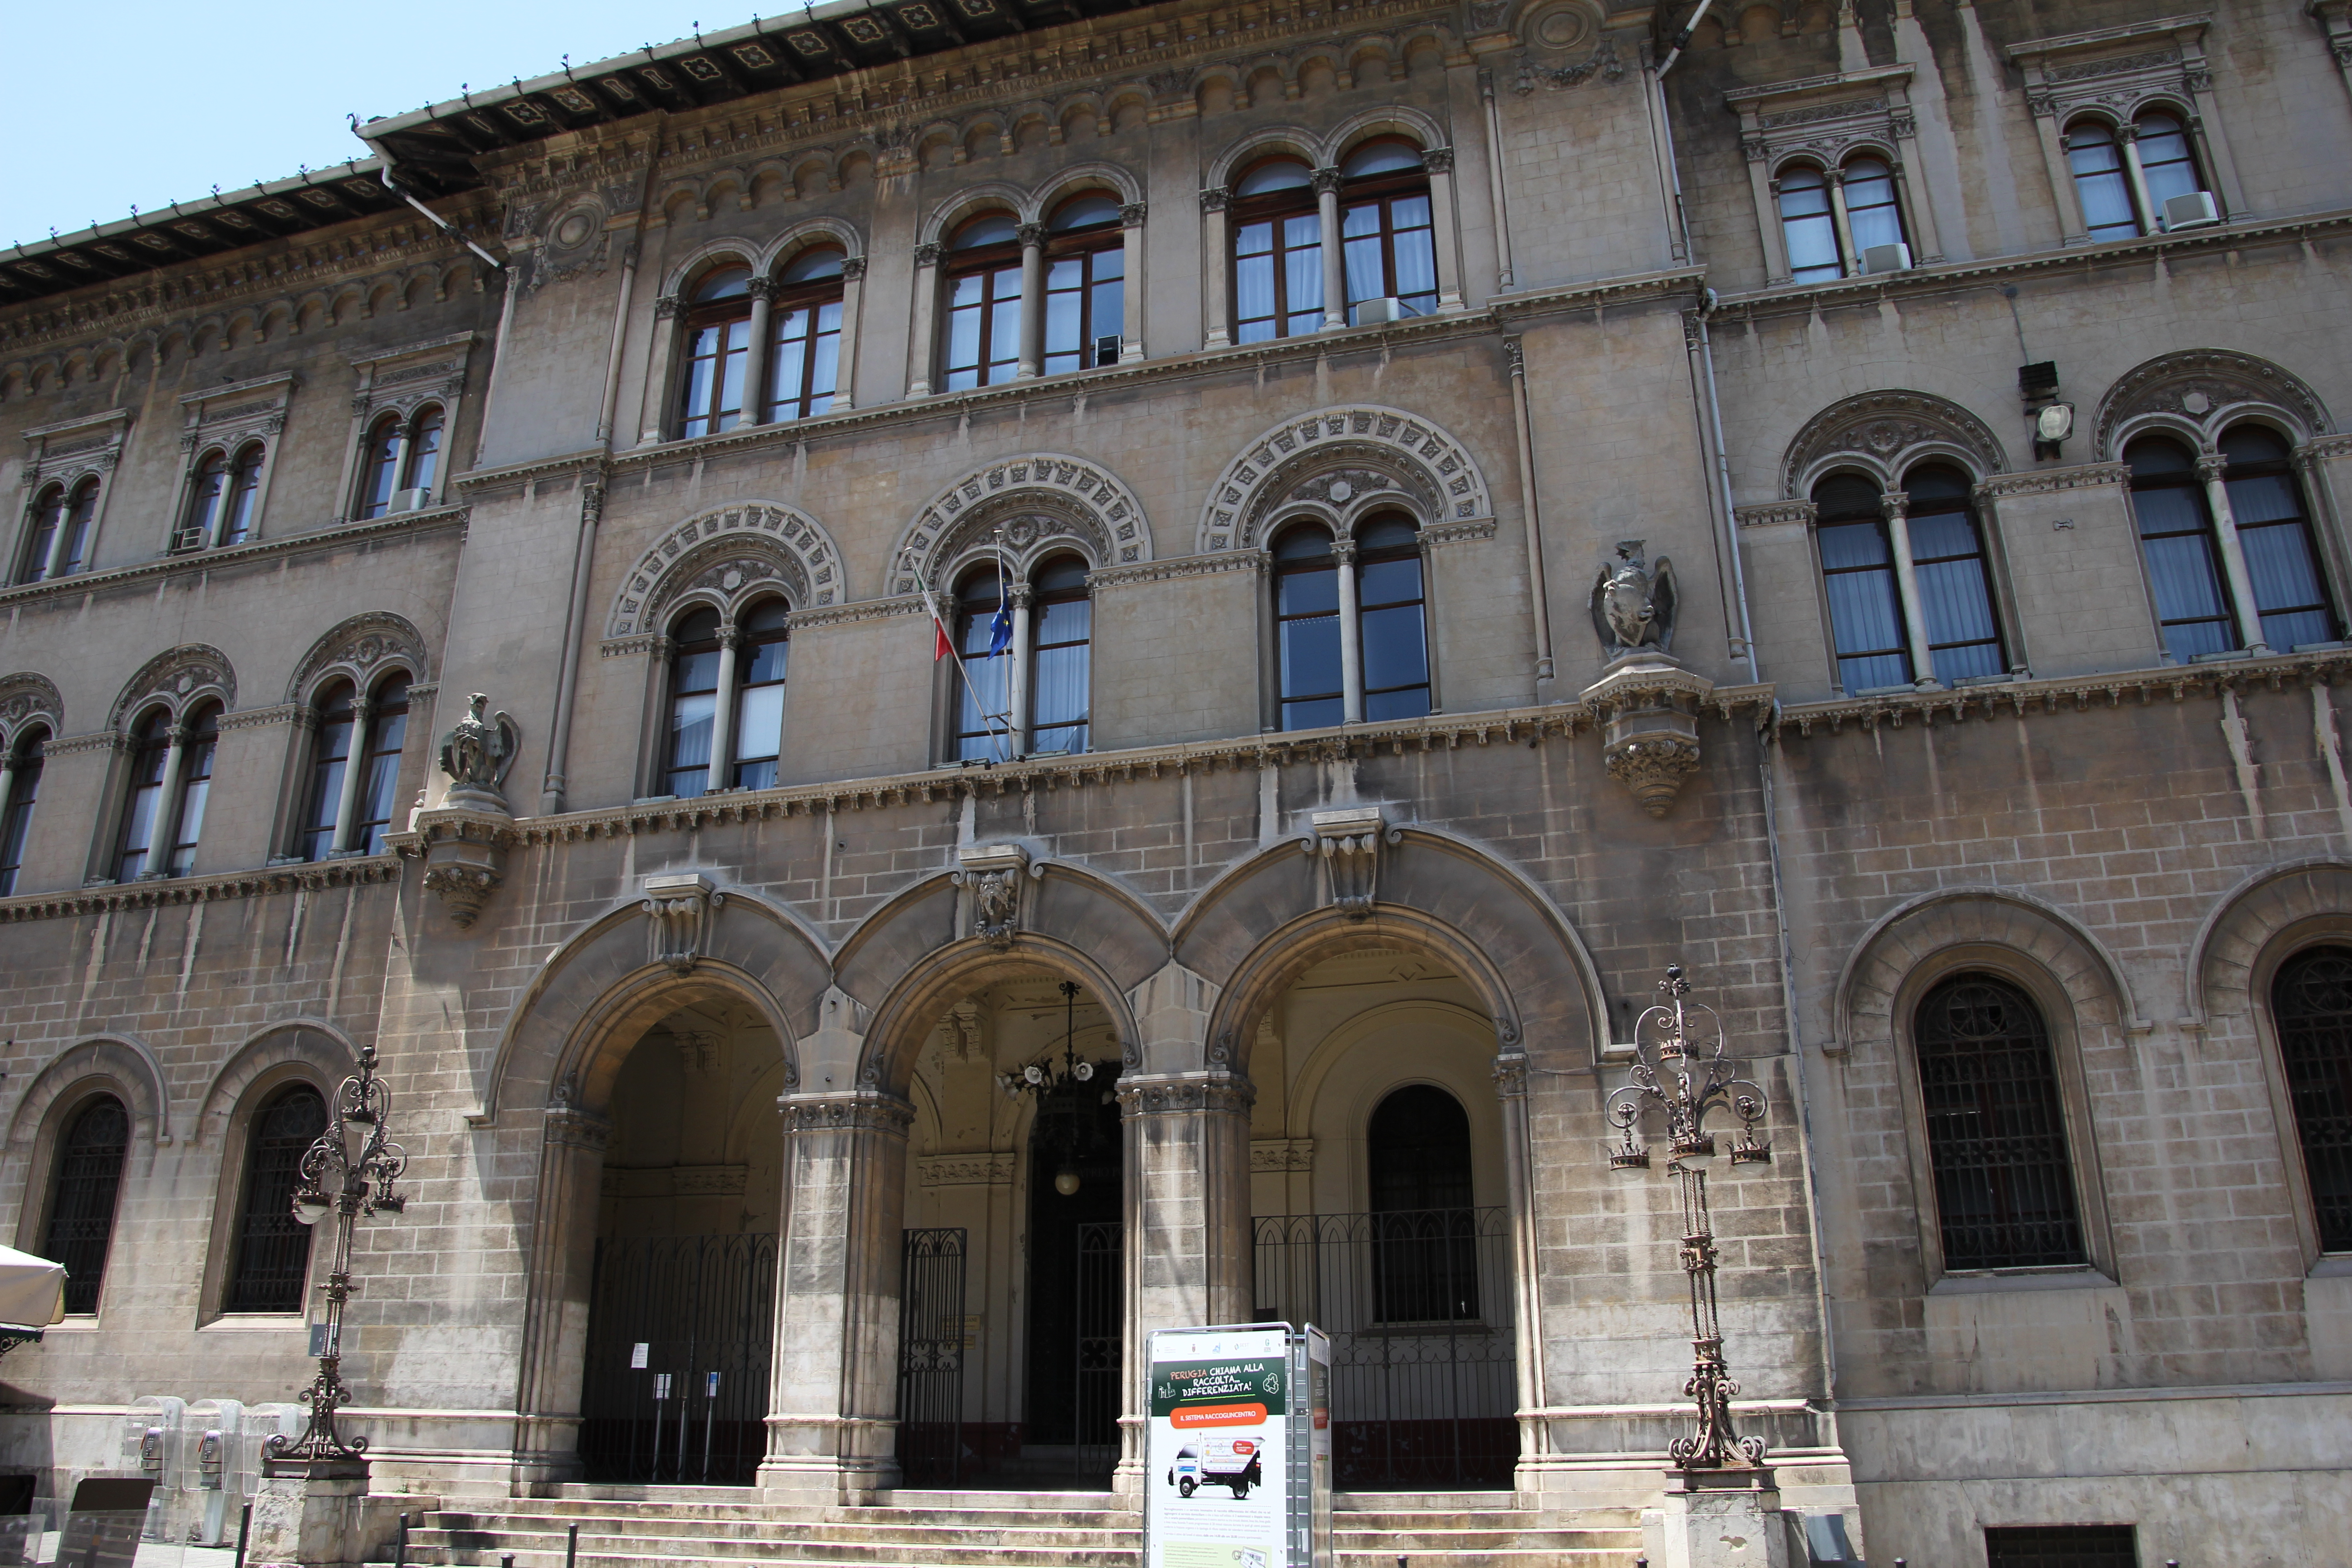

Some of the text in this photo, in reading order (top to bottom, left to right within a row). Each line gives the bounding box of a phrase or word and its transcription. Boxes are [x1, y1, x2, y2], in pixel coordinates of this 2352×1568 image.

[1171, 1363, 1264, 1380] PERUGIA CHIAMA ALLA
[1193, 1375, 1240, 1387] RACCOLTA...
[1182, 1382, 1251, 1396] DIFFERENZIATA!
[1205, 1411, 1256, 1420] RACCOGLINCENTRO
